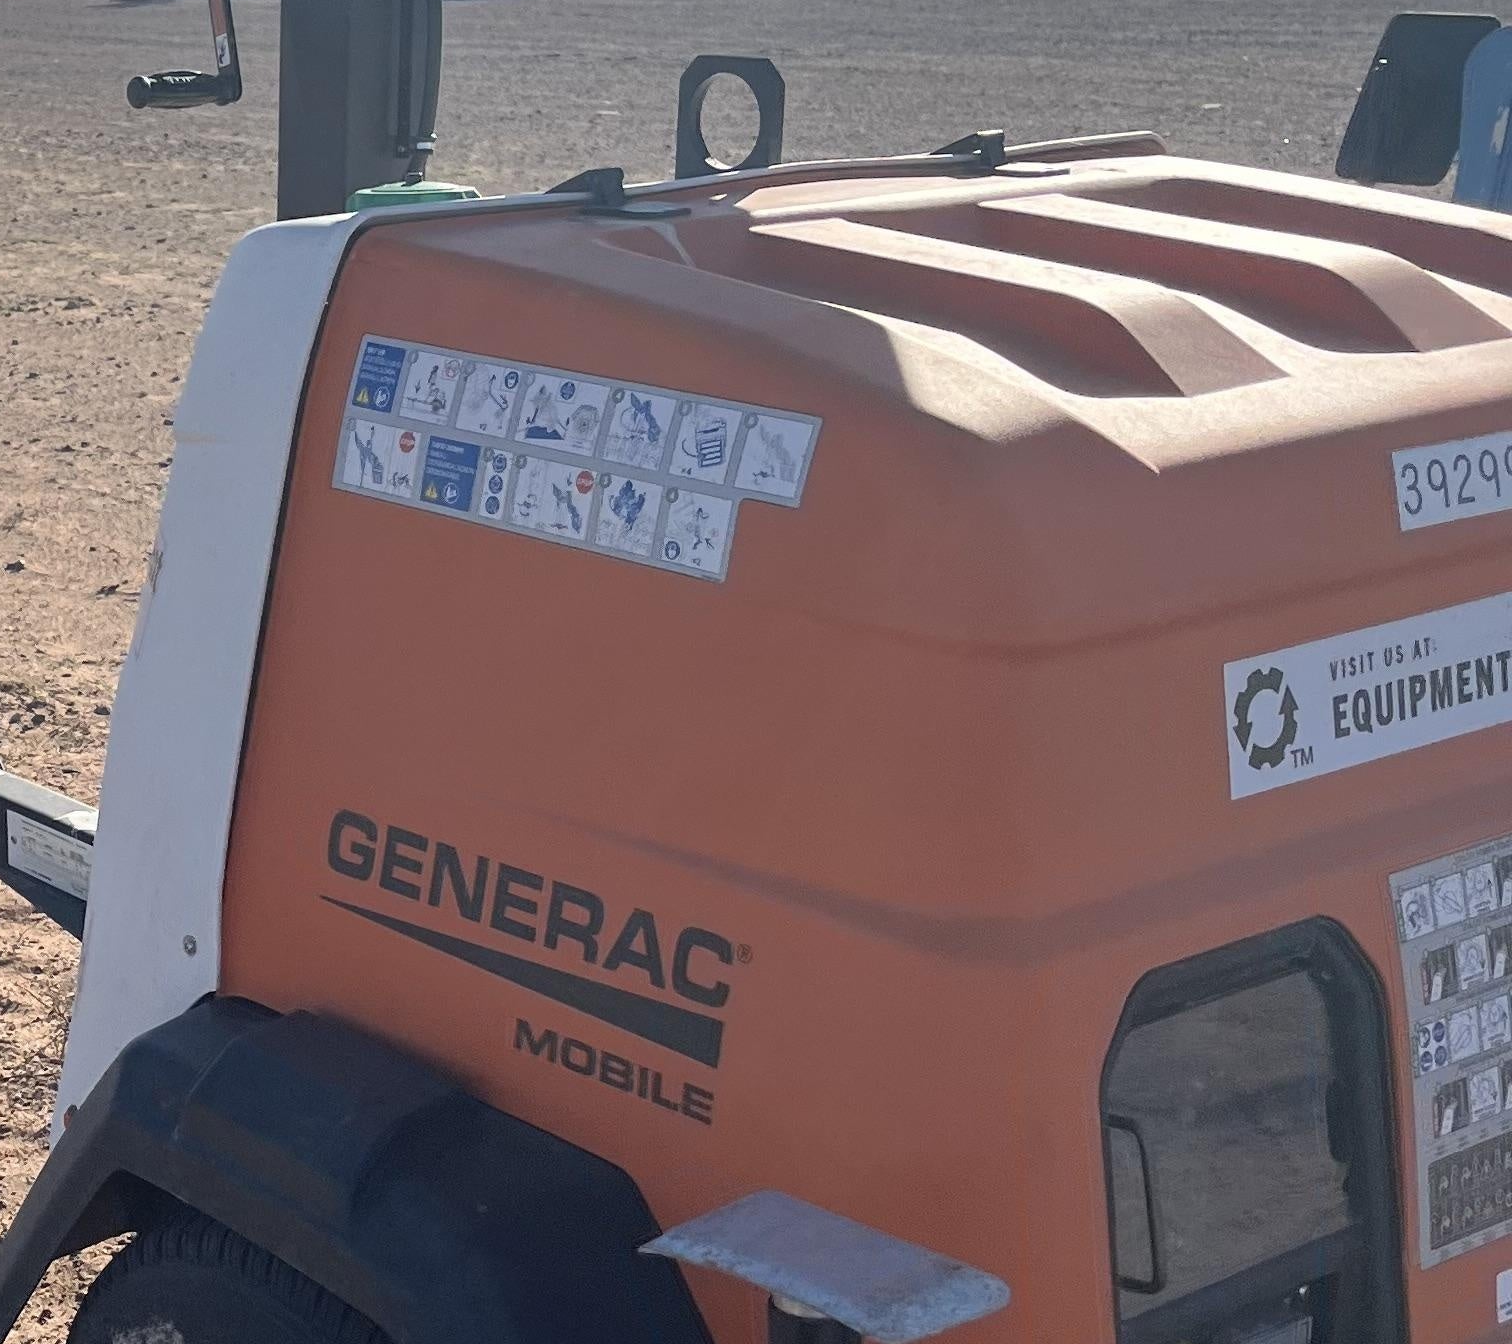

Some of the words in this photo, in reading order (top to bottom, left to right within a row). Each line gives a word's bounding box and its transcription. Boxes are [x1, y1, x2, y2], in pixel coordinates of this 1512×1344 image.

[1329, 651, 1374, 681] VISIT
[1383, 644, 1404, 667] US
[1332, 650, 1512, 739] EQUIPMENT
[1290, 745, 1314, 768] TM
[512, 1017, 715, 1125] MOBILE
